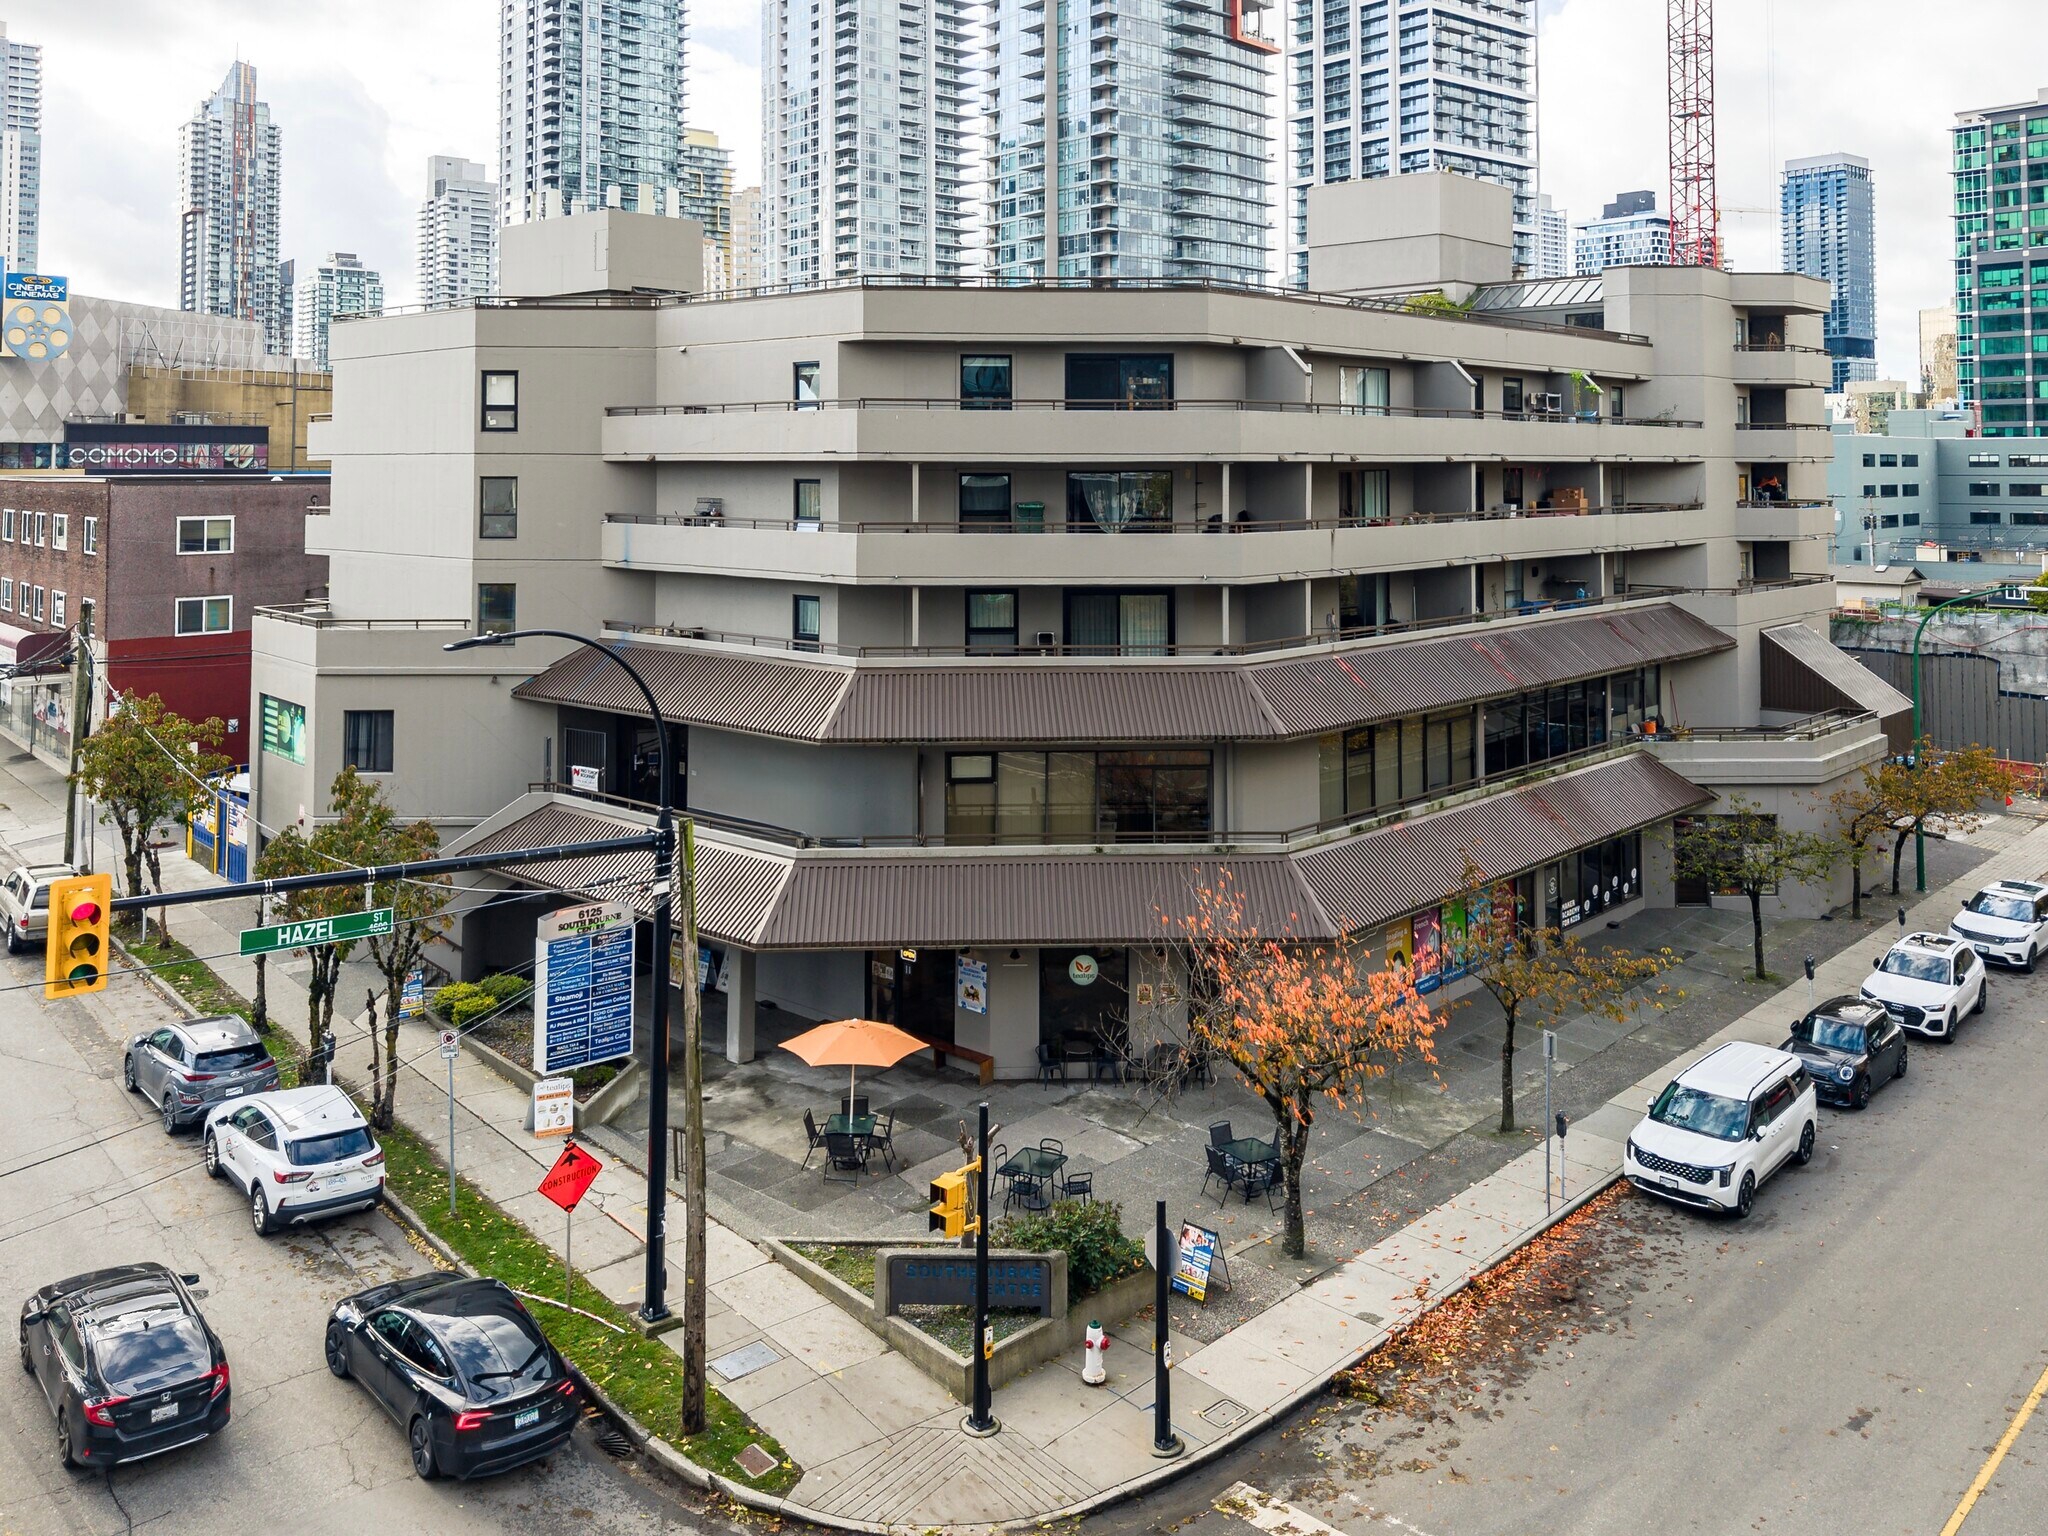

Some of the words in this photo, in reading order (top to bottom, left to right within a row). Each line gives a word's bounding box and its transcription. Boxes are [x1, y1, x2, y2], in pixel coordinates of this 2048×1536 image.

[8, 283, 65, 293] CINEPLEX
[14, 290, 59, 299] CINEMAS
[1561, 899, 1576, 911] MAKER
[1561, 905, 1580, 918] ACADEMY
[578, 907, 603, 919] 6125
[558, 920, 586, 931] SOUTH
[588, 912, 622, 925] BOURNE
[1561, 917, 1570, 927] FOR
[1570, 914, 1580, 924] KIDS
[277, 920, 339, 945] HAZEL
[373, 912, 384, 923] ST
[555, 991, 583, 1004] Steamoji
[613, 994, 629, 1003] College
[595, 1035, 614, 1045] Tealips
[615, 1032, 627, 1040] Cafe
[546, 1083, 571, 1091] tealips
[542, 1165, 597, 1192] CONSTRUCTION
